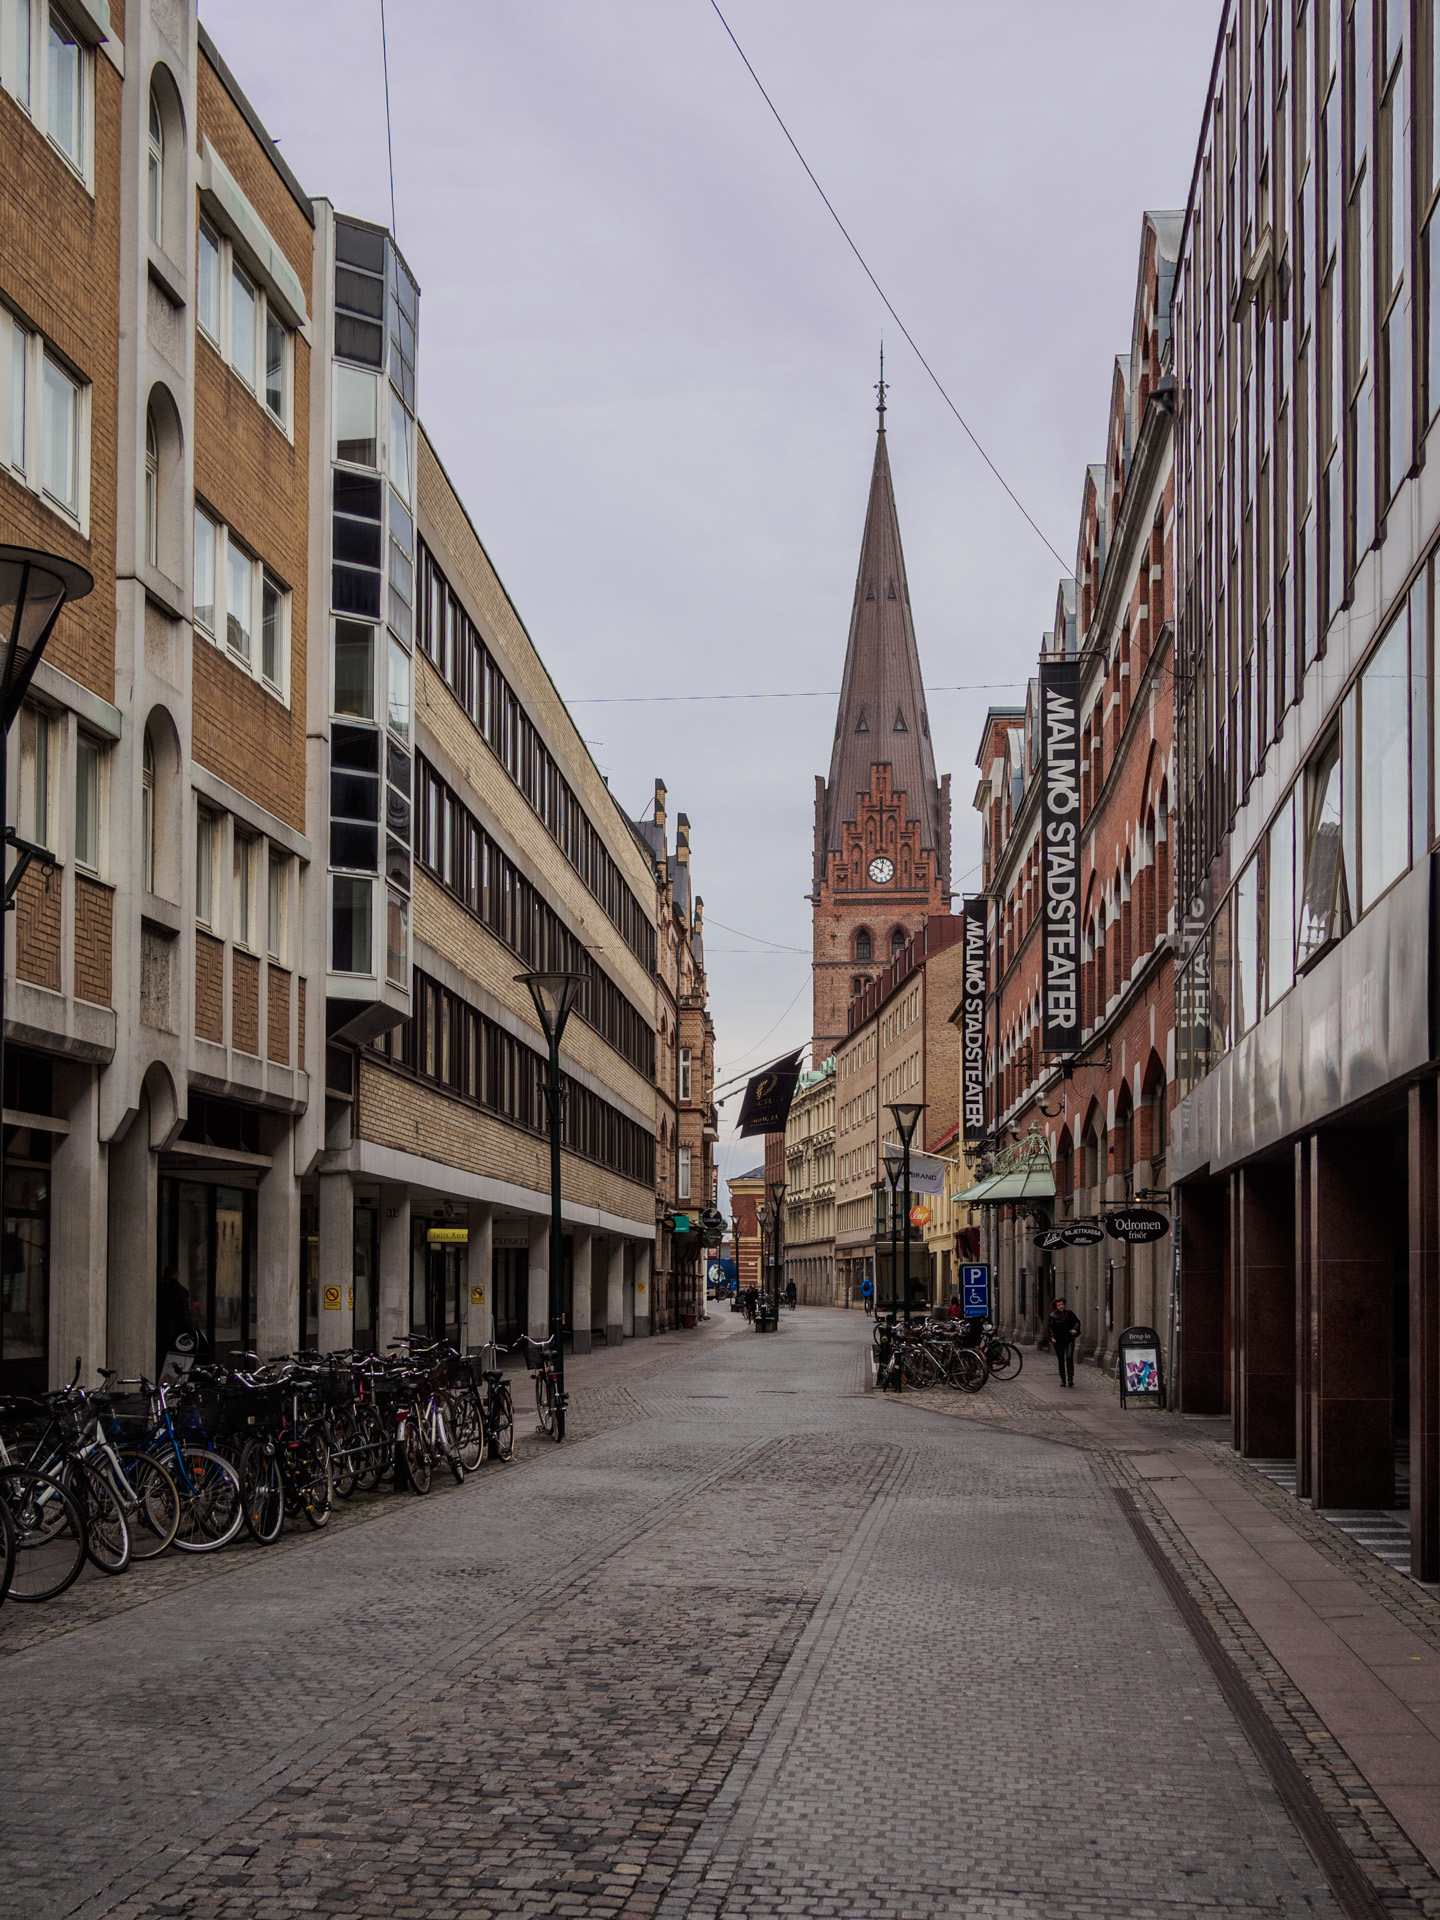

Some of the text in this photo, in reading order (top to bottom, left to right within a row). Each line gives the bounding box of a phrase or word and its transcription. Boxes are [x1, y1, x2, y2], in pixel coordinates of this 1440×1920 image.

[1046, 687, 1079, 1030] MALMÖ STADSTEATER
[965, 916, 985, 1128] MALMÖ STADSTEATER
[910, 1172, 937, 1181] BRAND
[1128, 1230, 1147, 1239] frisör
[970, 1268, 981, 1284] P
